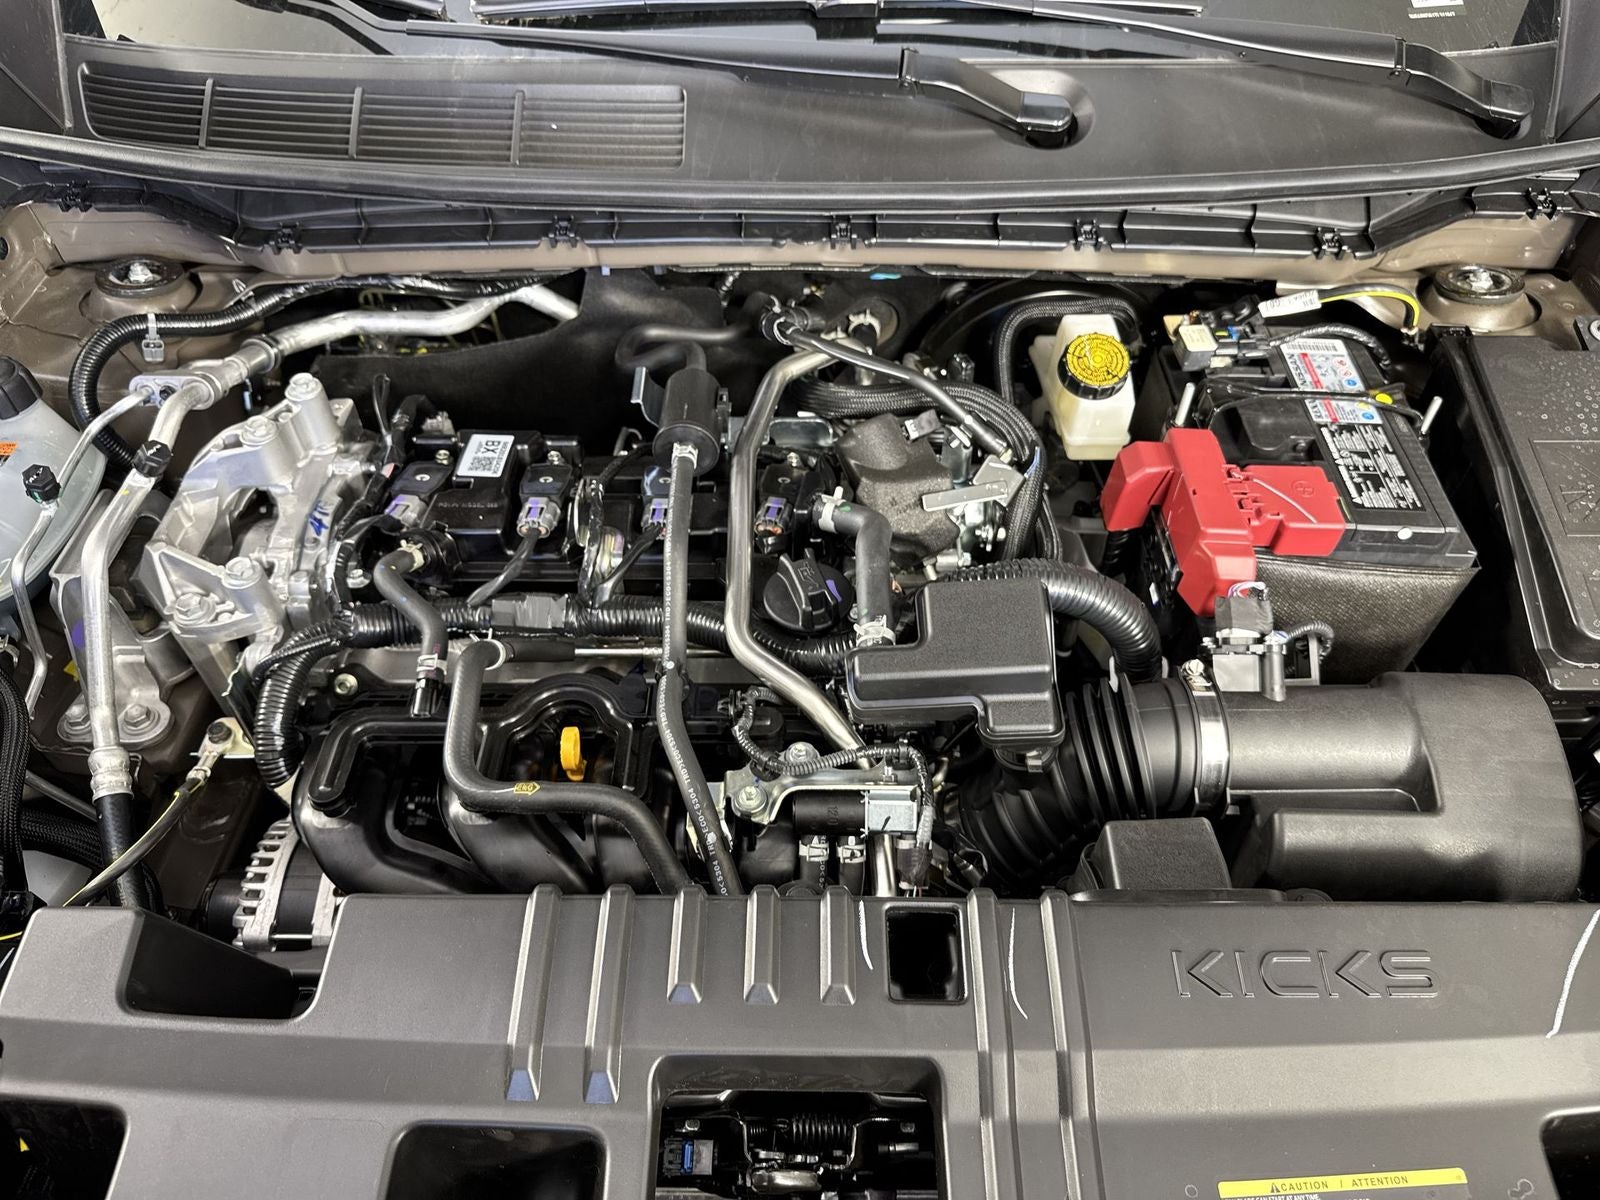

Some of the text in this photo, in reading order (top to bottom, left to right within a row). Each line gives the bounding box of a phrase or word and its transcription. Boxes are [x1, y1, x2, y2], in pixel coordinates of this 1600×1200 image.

[481, 440, 501, 454] BX
[1171, 949, 1439, 998] KICKS
[1280, 1180, 1329, 1192] CAUTION
[1351, 1175, 1409, 1188] ATTENTION
